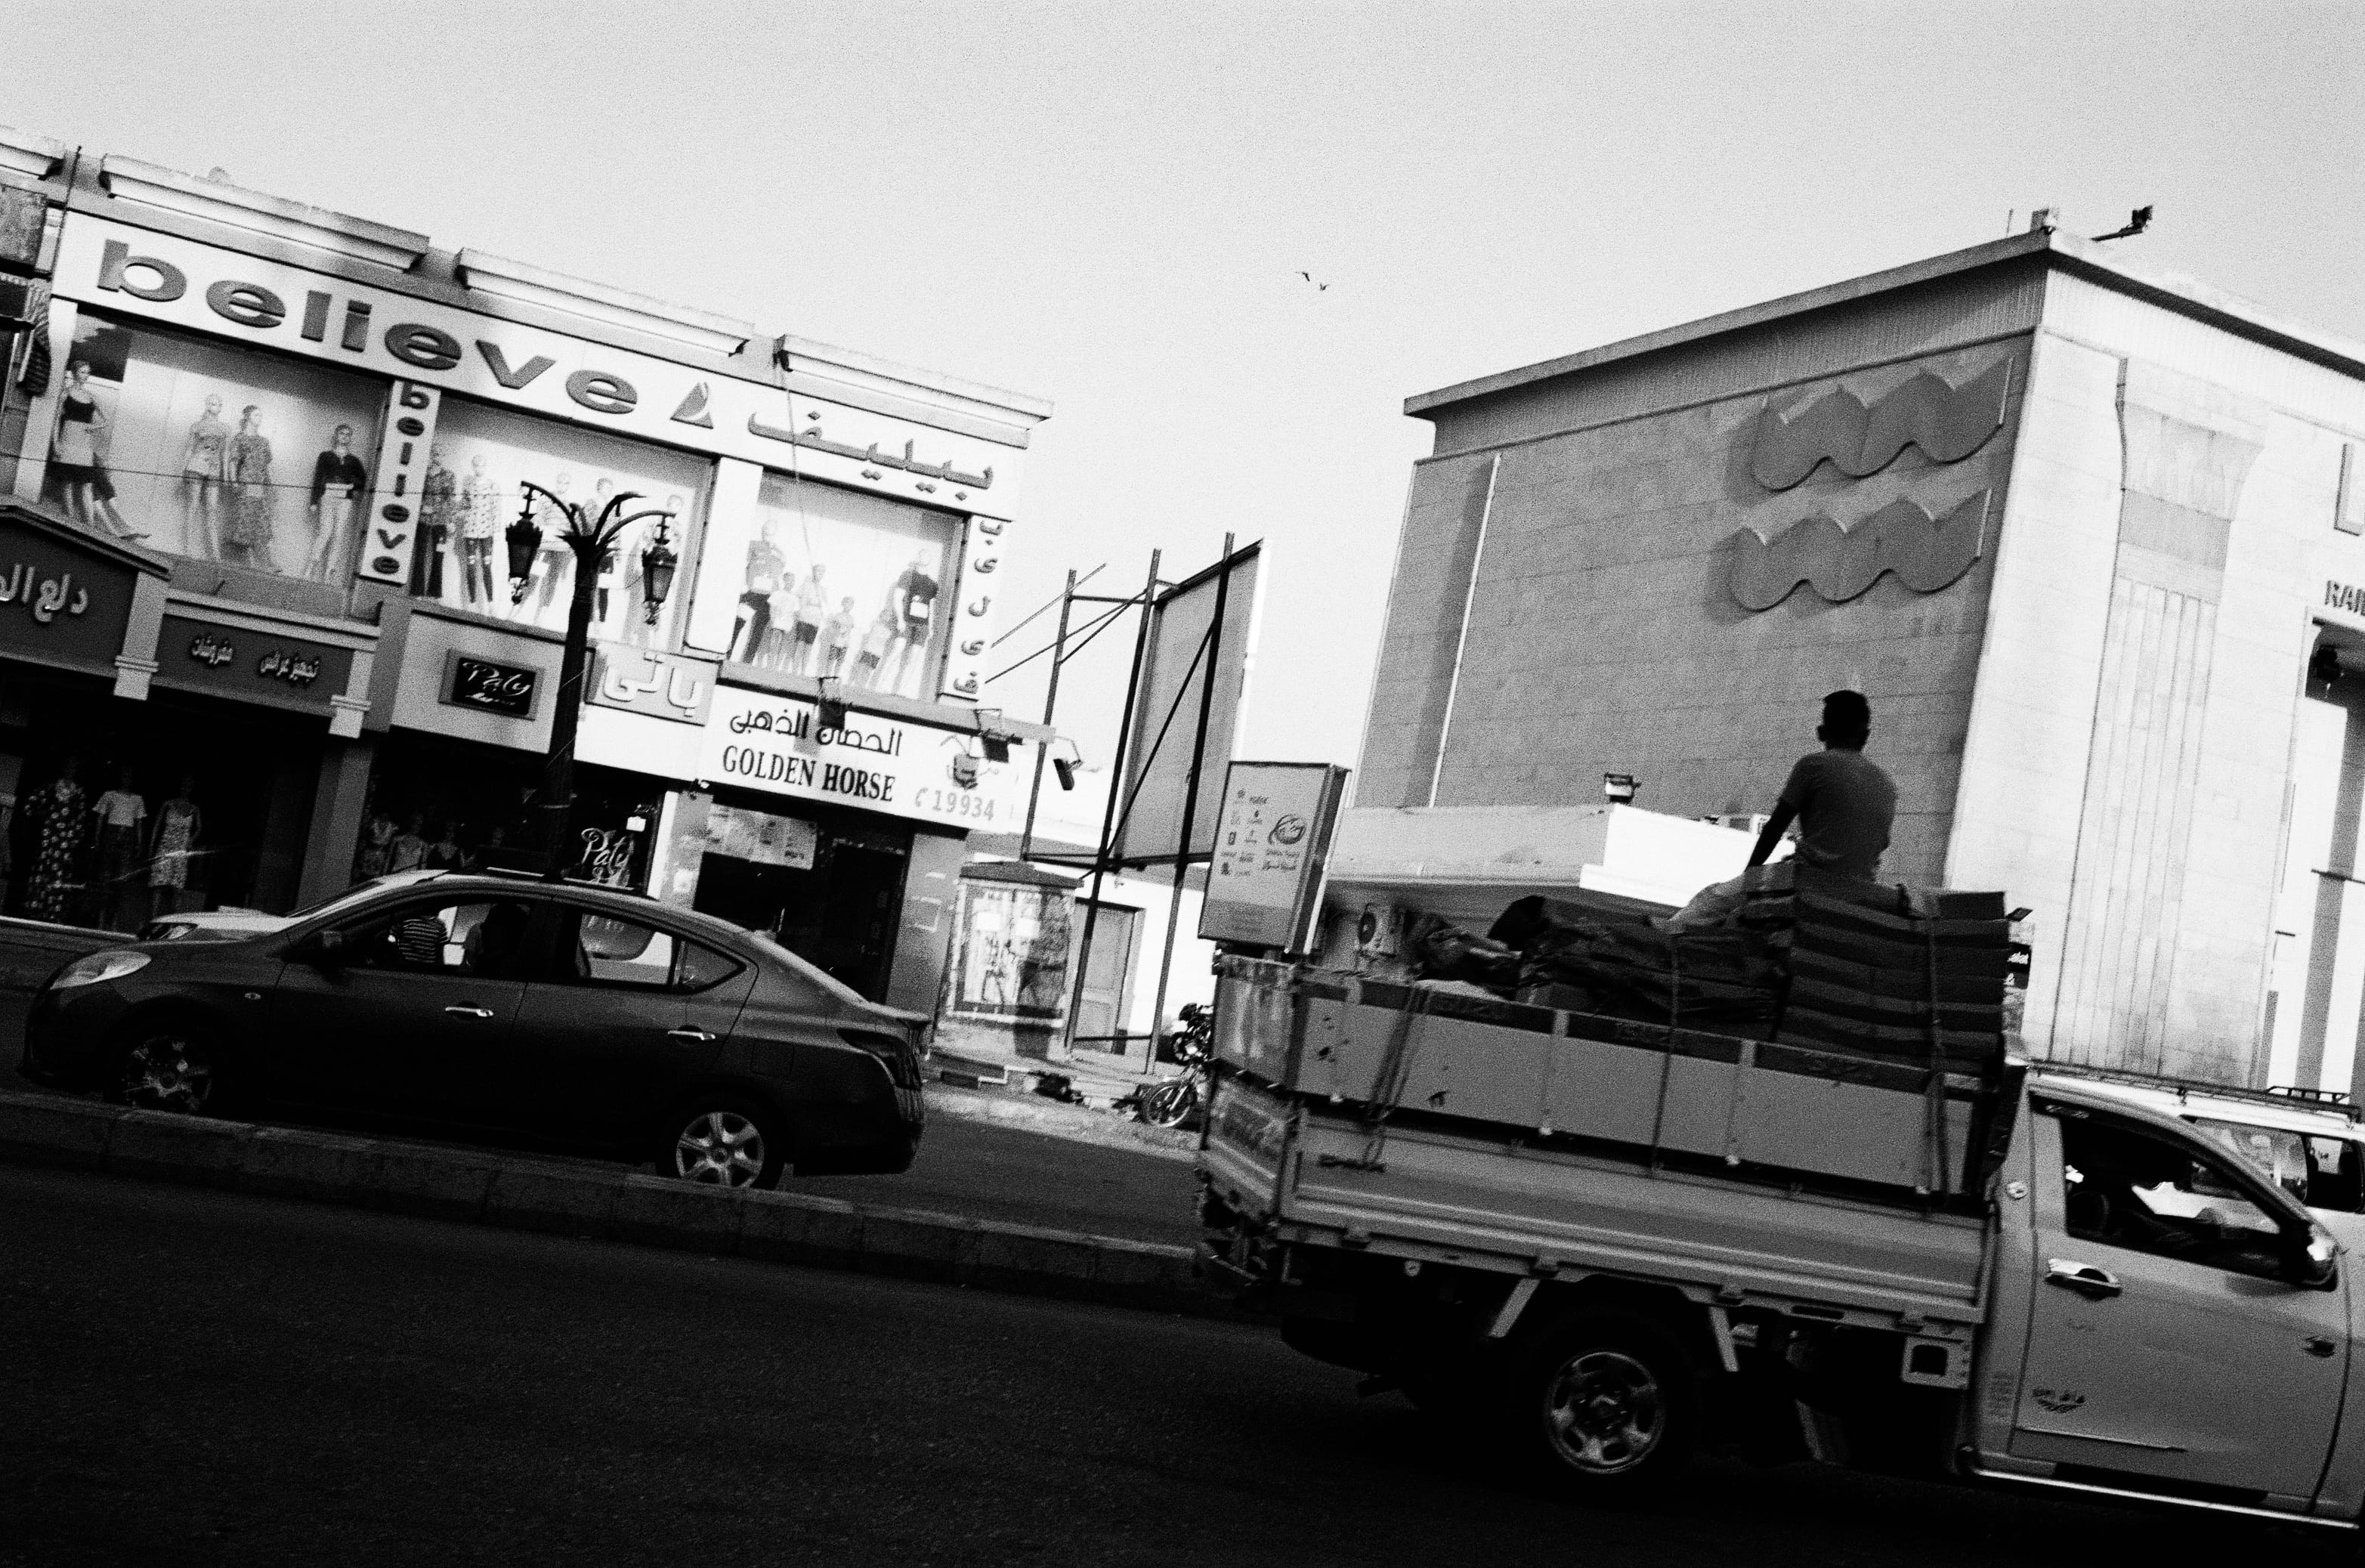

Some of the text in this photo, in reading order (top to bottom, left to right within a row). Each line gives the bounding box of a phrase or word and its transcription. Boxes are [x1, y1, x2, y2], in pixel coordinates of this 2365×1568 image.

[97, 239, 638, 415] believe
[373, 380, 431, 575] believe
[722, 744, 896, 803] GOLDEN HORSE
[932, 789, 996, 821] 19934
